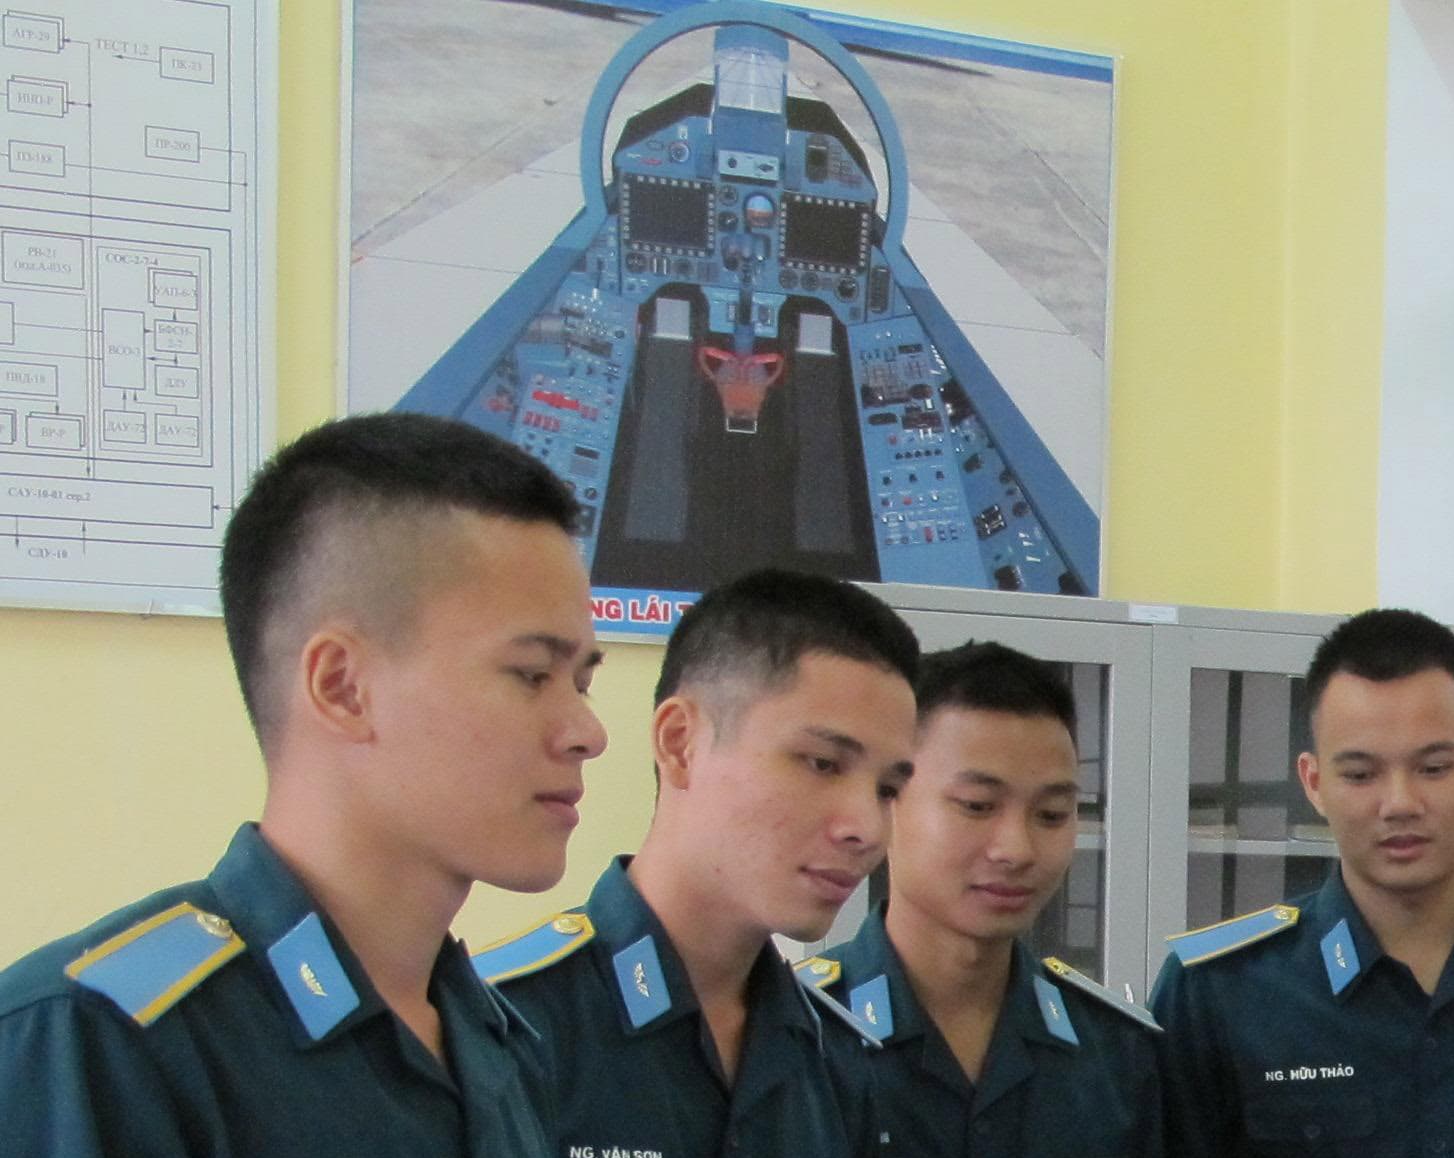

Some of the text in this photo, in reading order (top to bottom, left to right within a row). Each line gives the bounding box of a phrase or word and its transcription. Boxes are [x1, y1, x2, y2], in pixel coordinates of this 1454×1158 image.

[629, 595, 671, 623] LÁI
[1265, 1063, 1355, 1081] NG. HỮU THẢO
